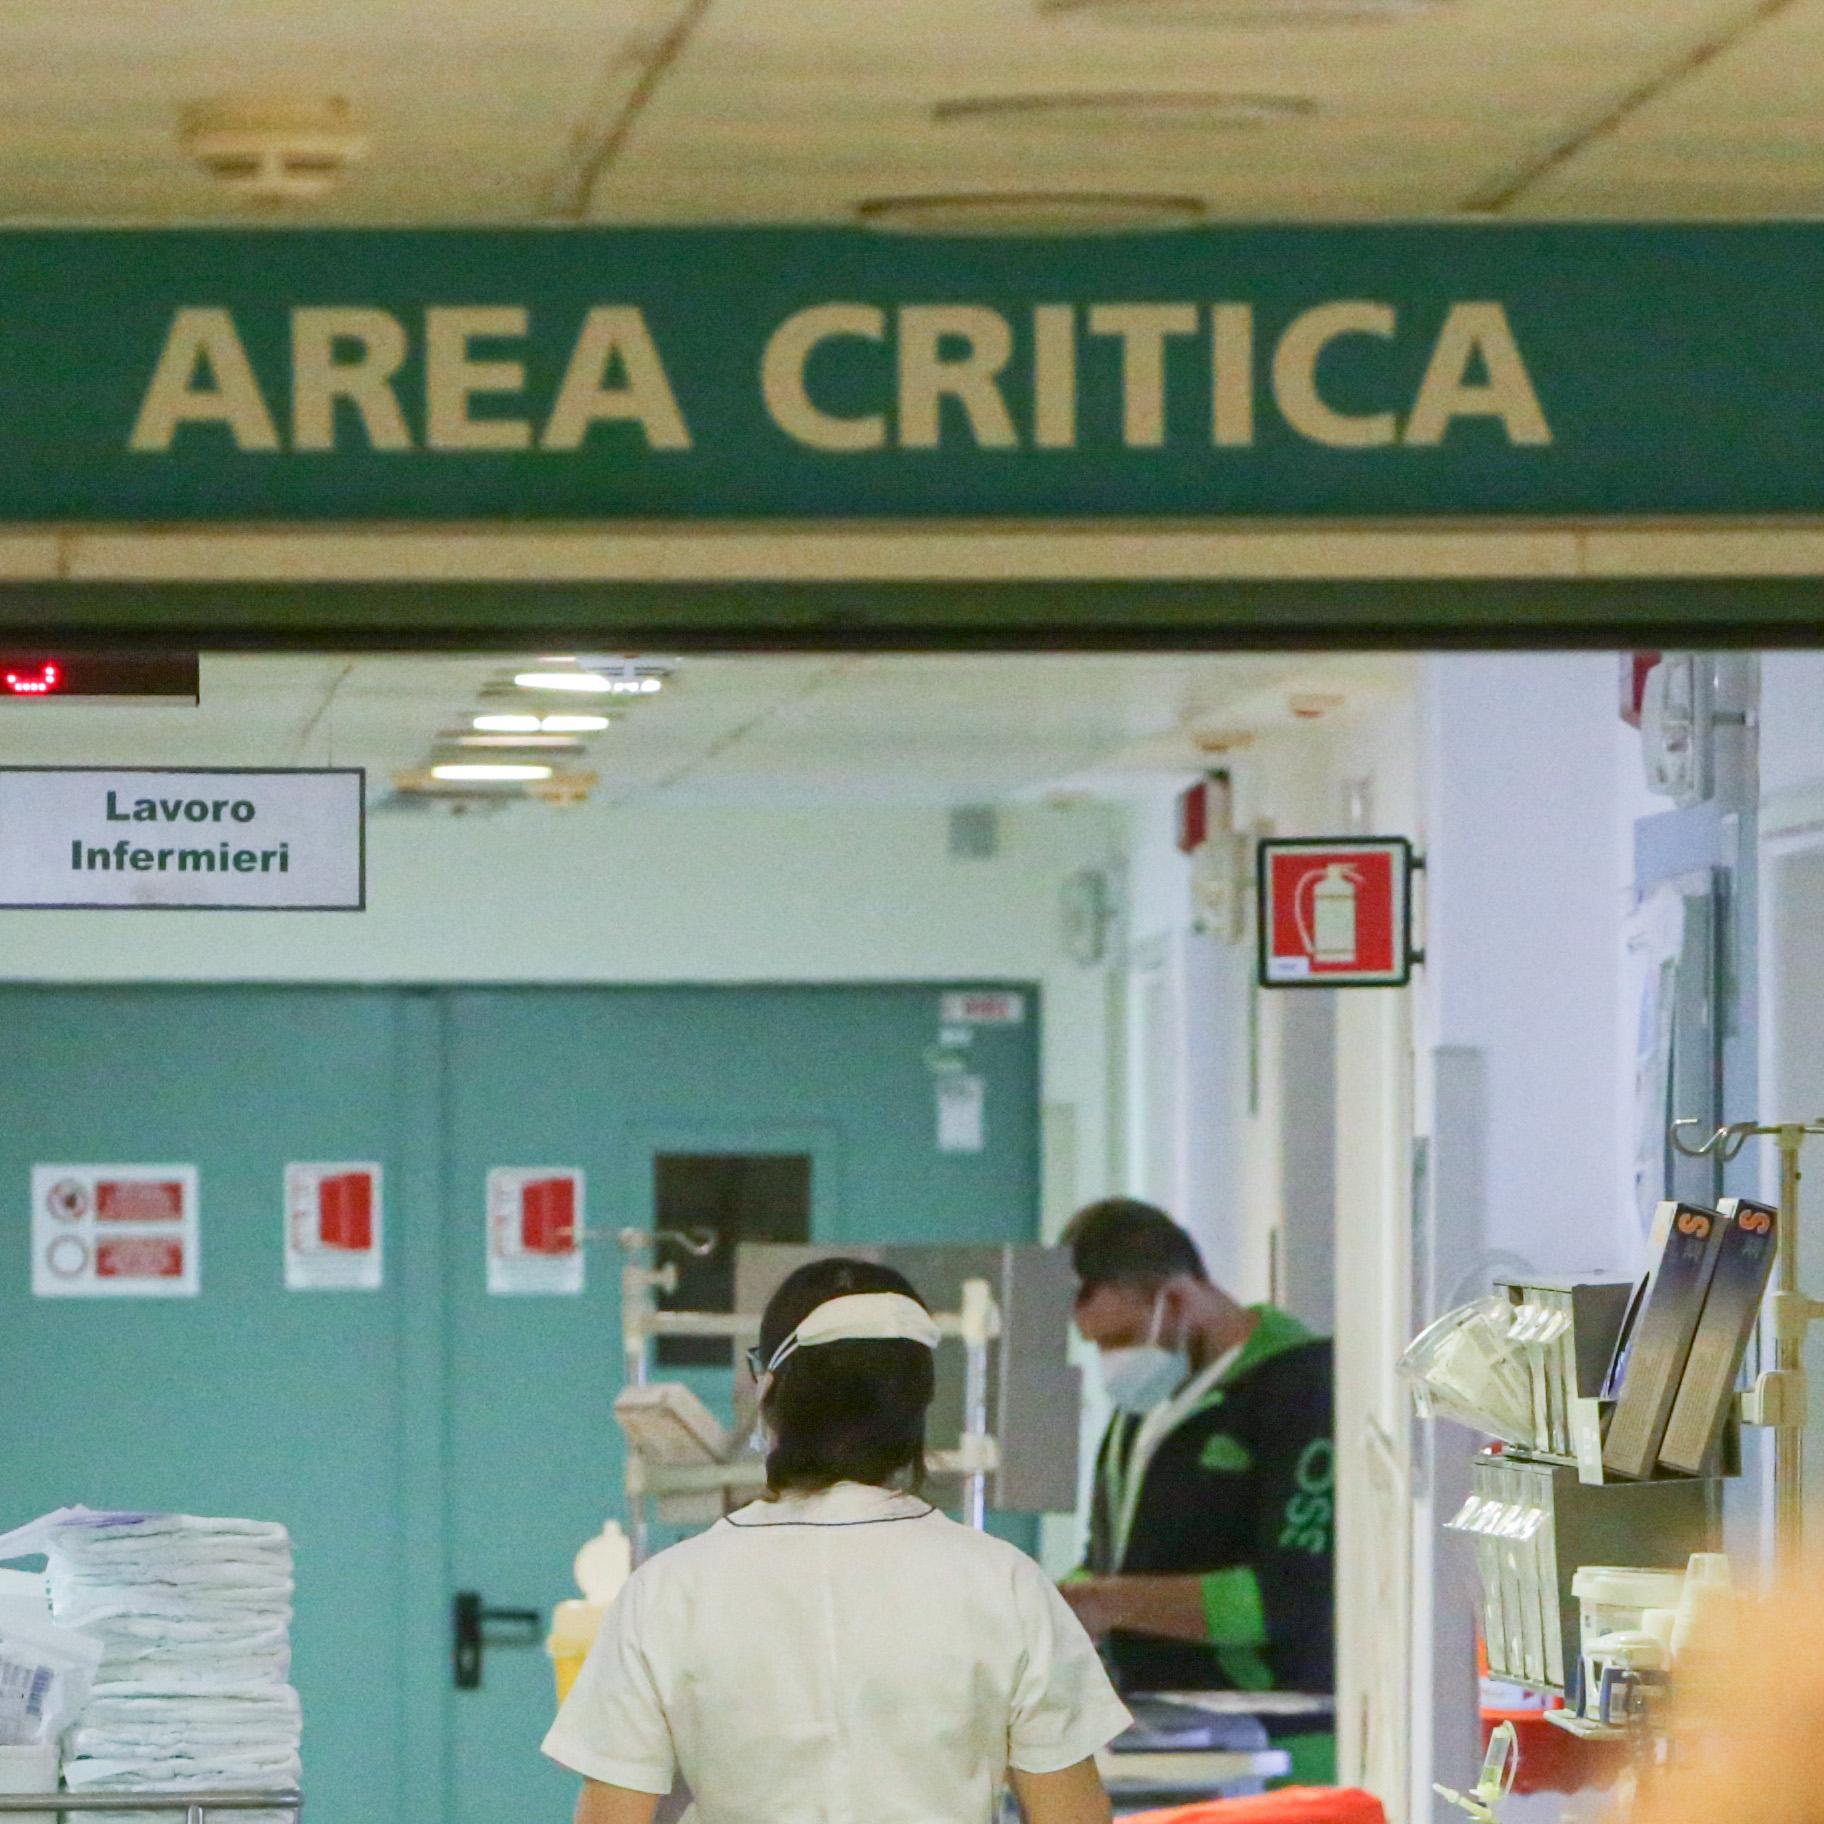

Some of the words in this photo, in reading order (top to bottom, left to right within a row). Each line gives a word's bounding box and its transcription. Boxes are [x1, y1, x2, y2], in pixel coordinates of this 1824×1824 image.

[127, 304, 693, 450] AREA
[761, 300, 1554, 452] CRITICA
[105, 790, 256, 823] Lavoro
[71, 839, 289, 873] Infermieri
